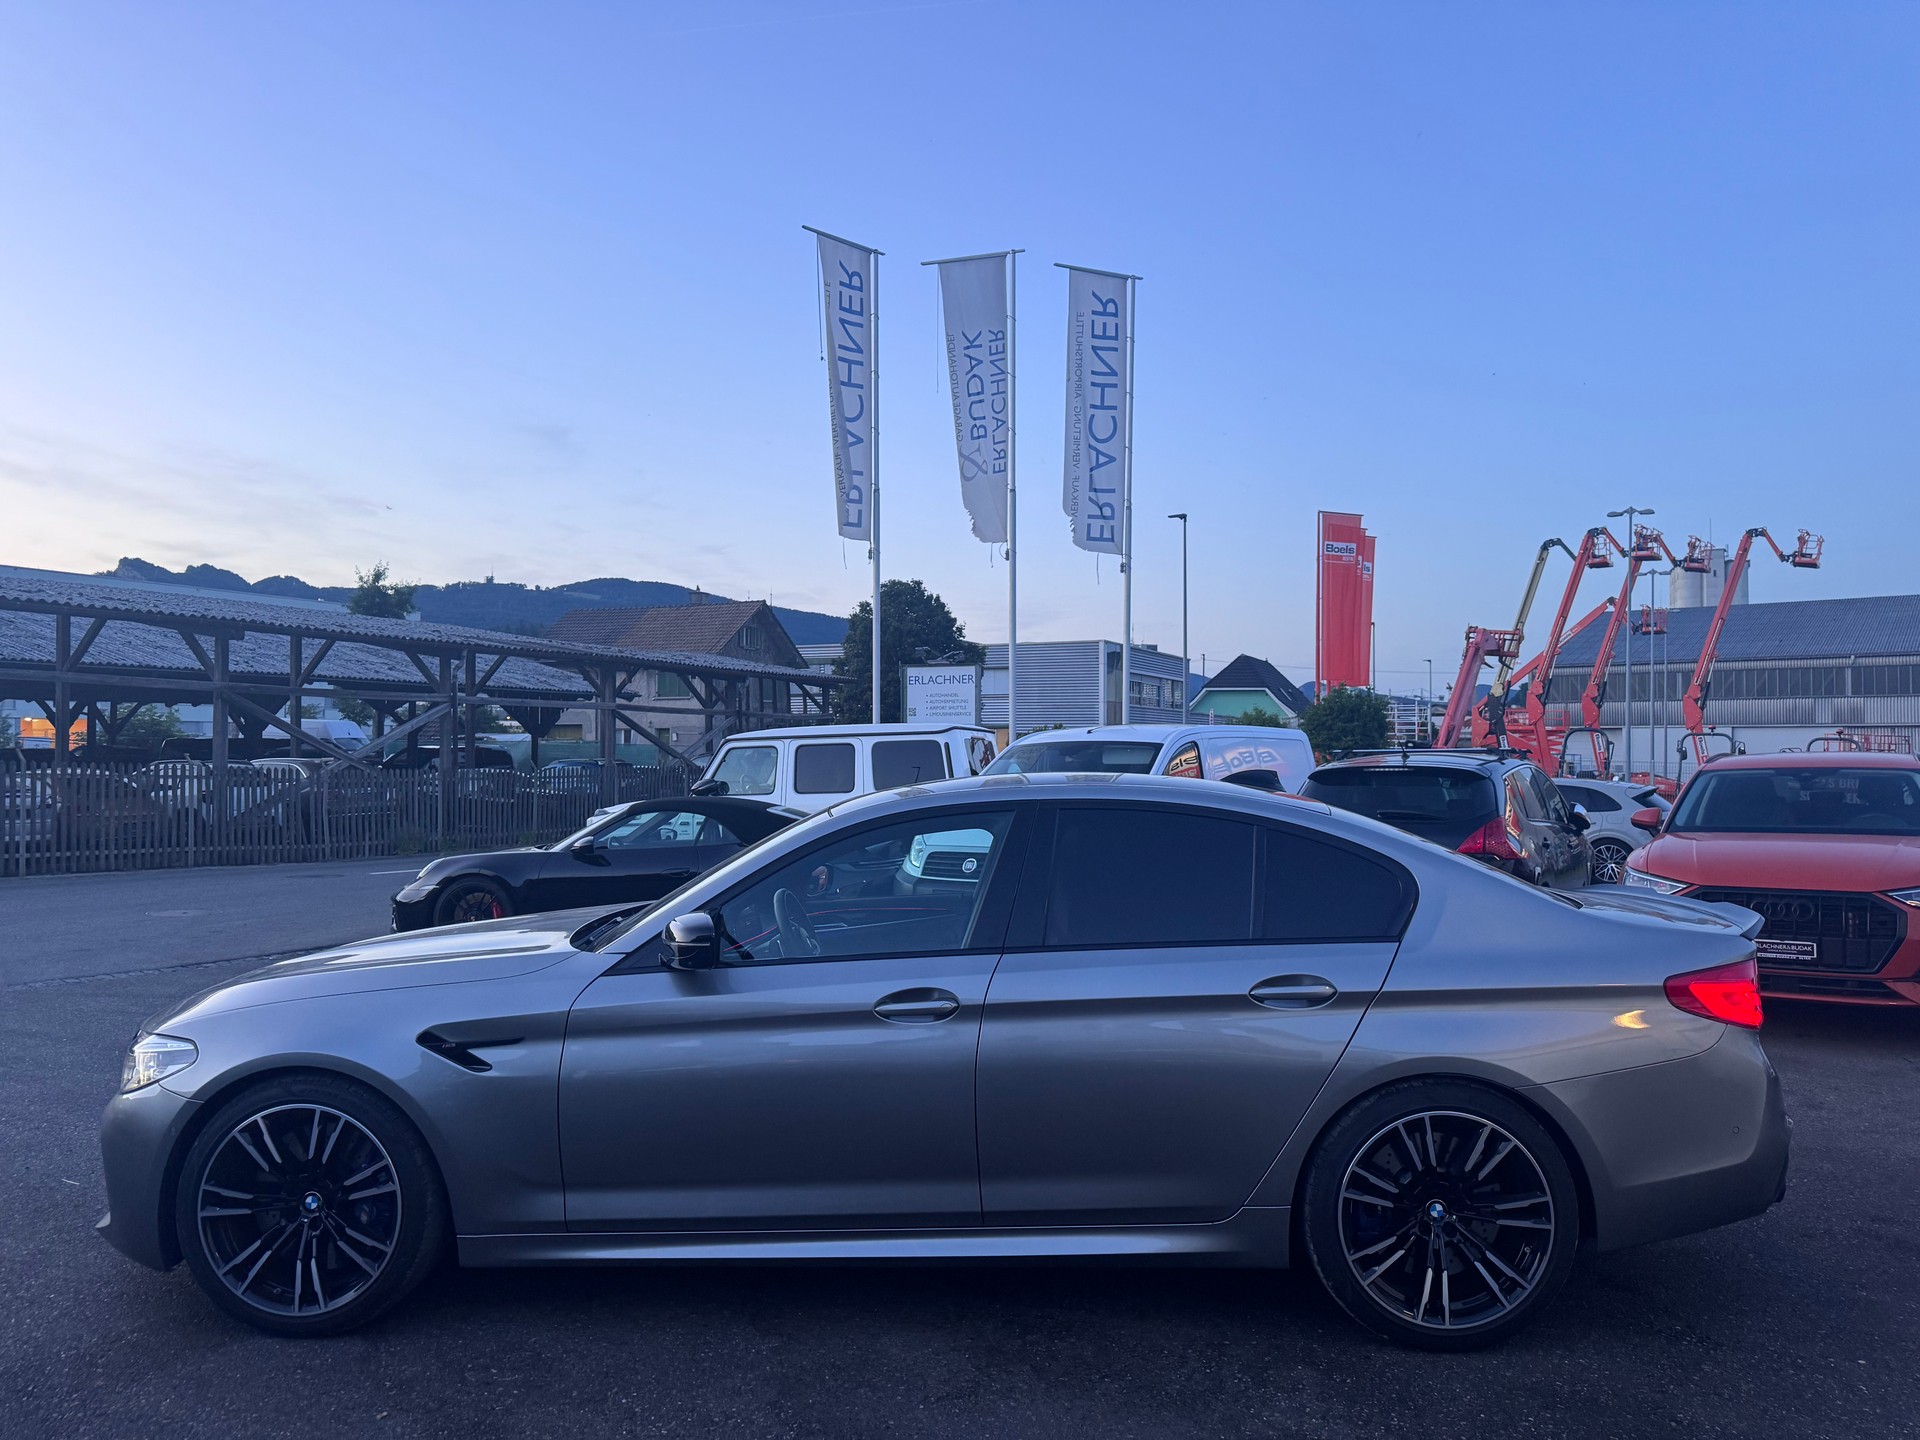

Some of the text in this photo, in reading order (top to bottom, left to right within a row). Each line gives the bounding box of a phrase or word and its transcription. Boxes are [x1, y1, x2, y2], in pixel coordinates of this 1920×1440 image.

[835, 452, 847, 498] VERKAUF
[1325, 543, 1355, 555] Boels
[908, 674, 975, 686] ERLACHNER
